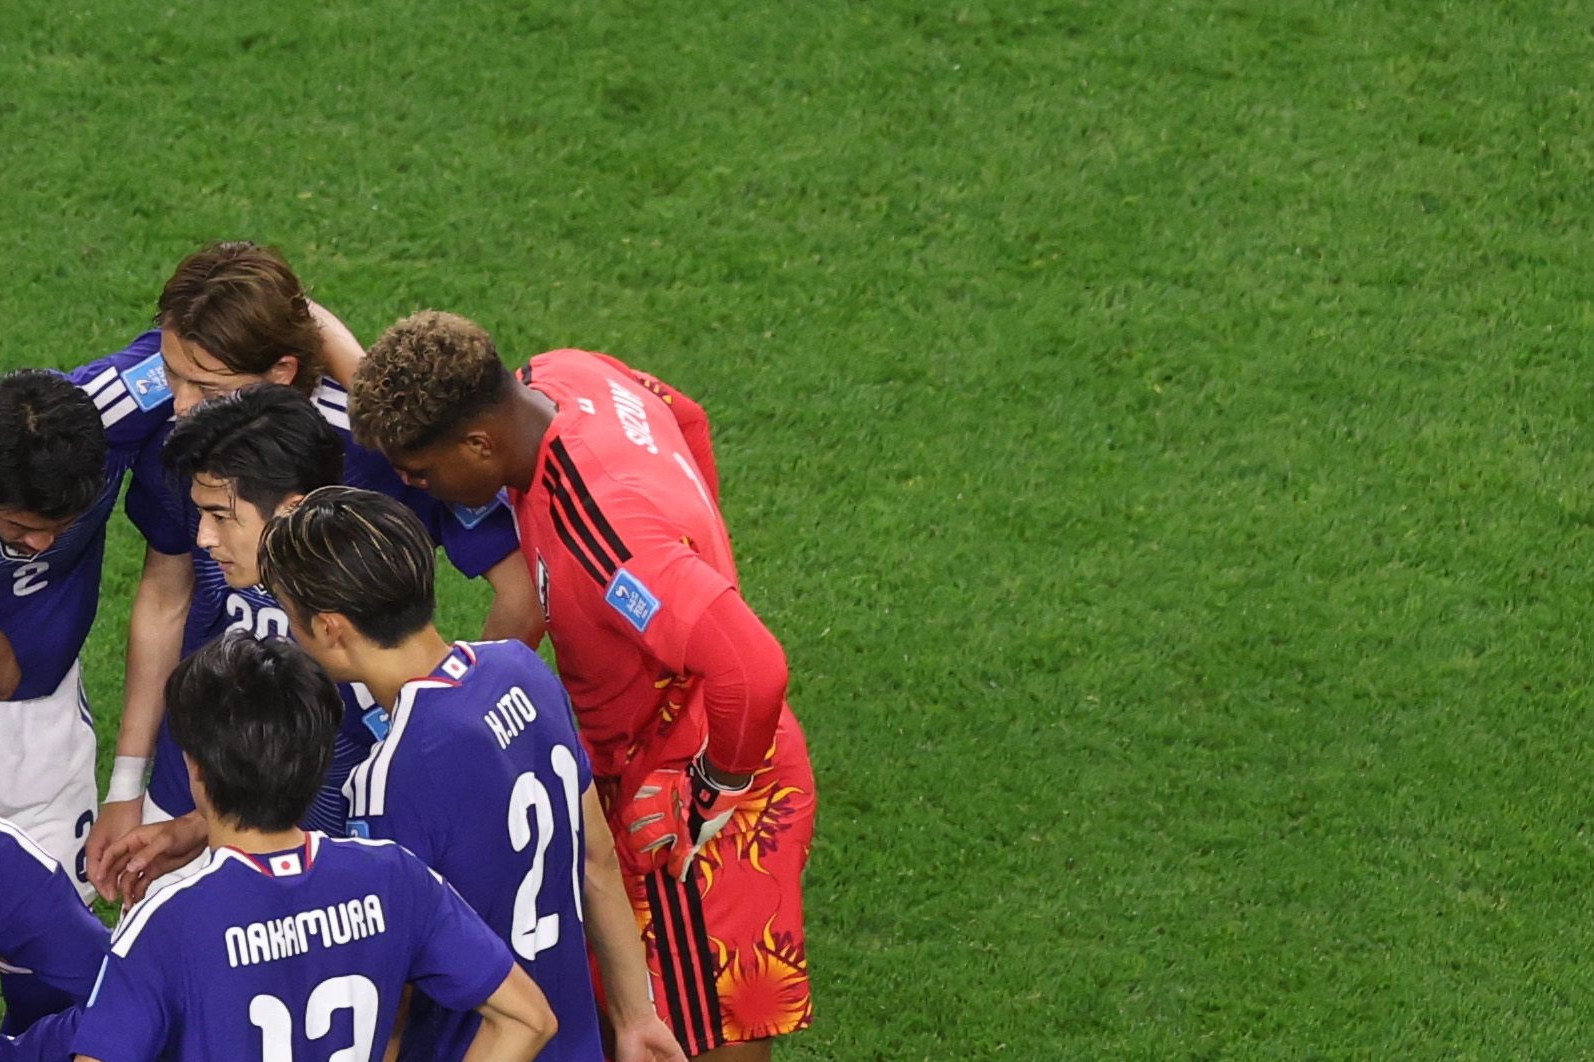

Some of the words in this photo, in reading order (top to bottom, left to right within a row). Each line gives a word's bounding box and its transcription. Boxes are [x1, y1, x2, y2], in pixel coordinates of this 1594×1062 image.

[606, 378, 659, 455] SUZUK
[12, 561, 50, 597] 2
[224, 593, 289, 642] 20
[484, 686, 537, 750] H.ITO
[508, 744, 583, 961] 21
[224, 894, 386, 968] NAKAMURA
